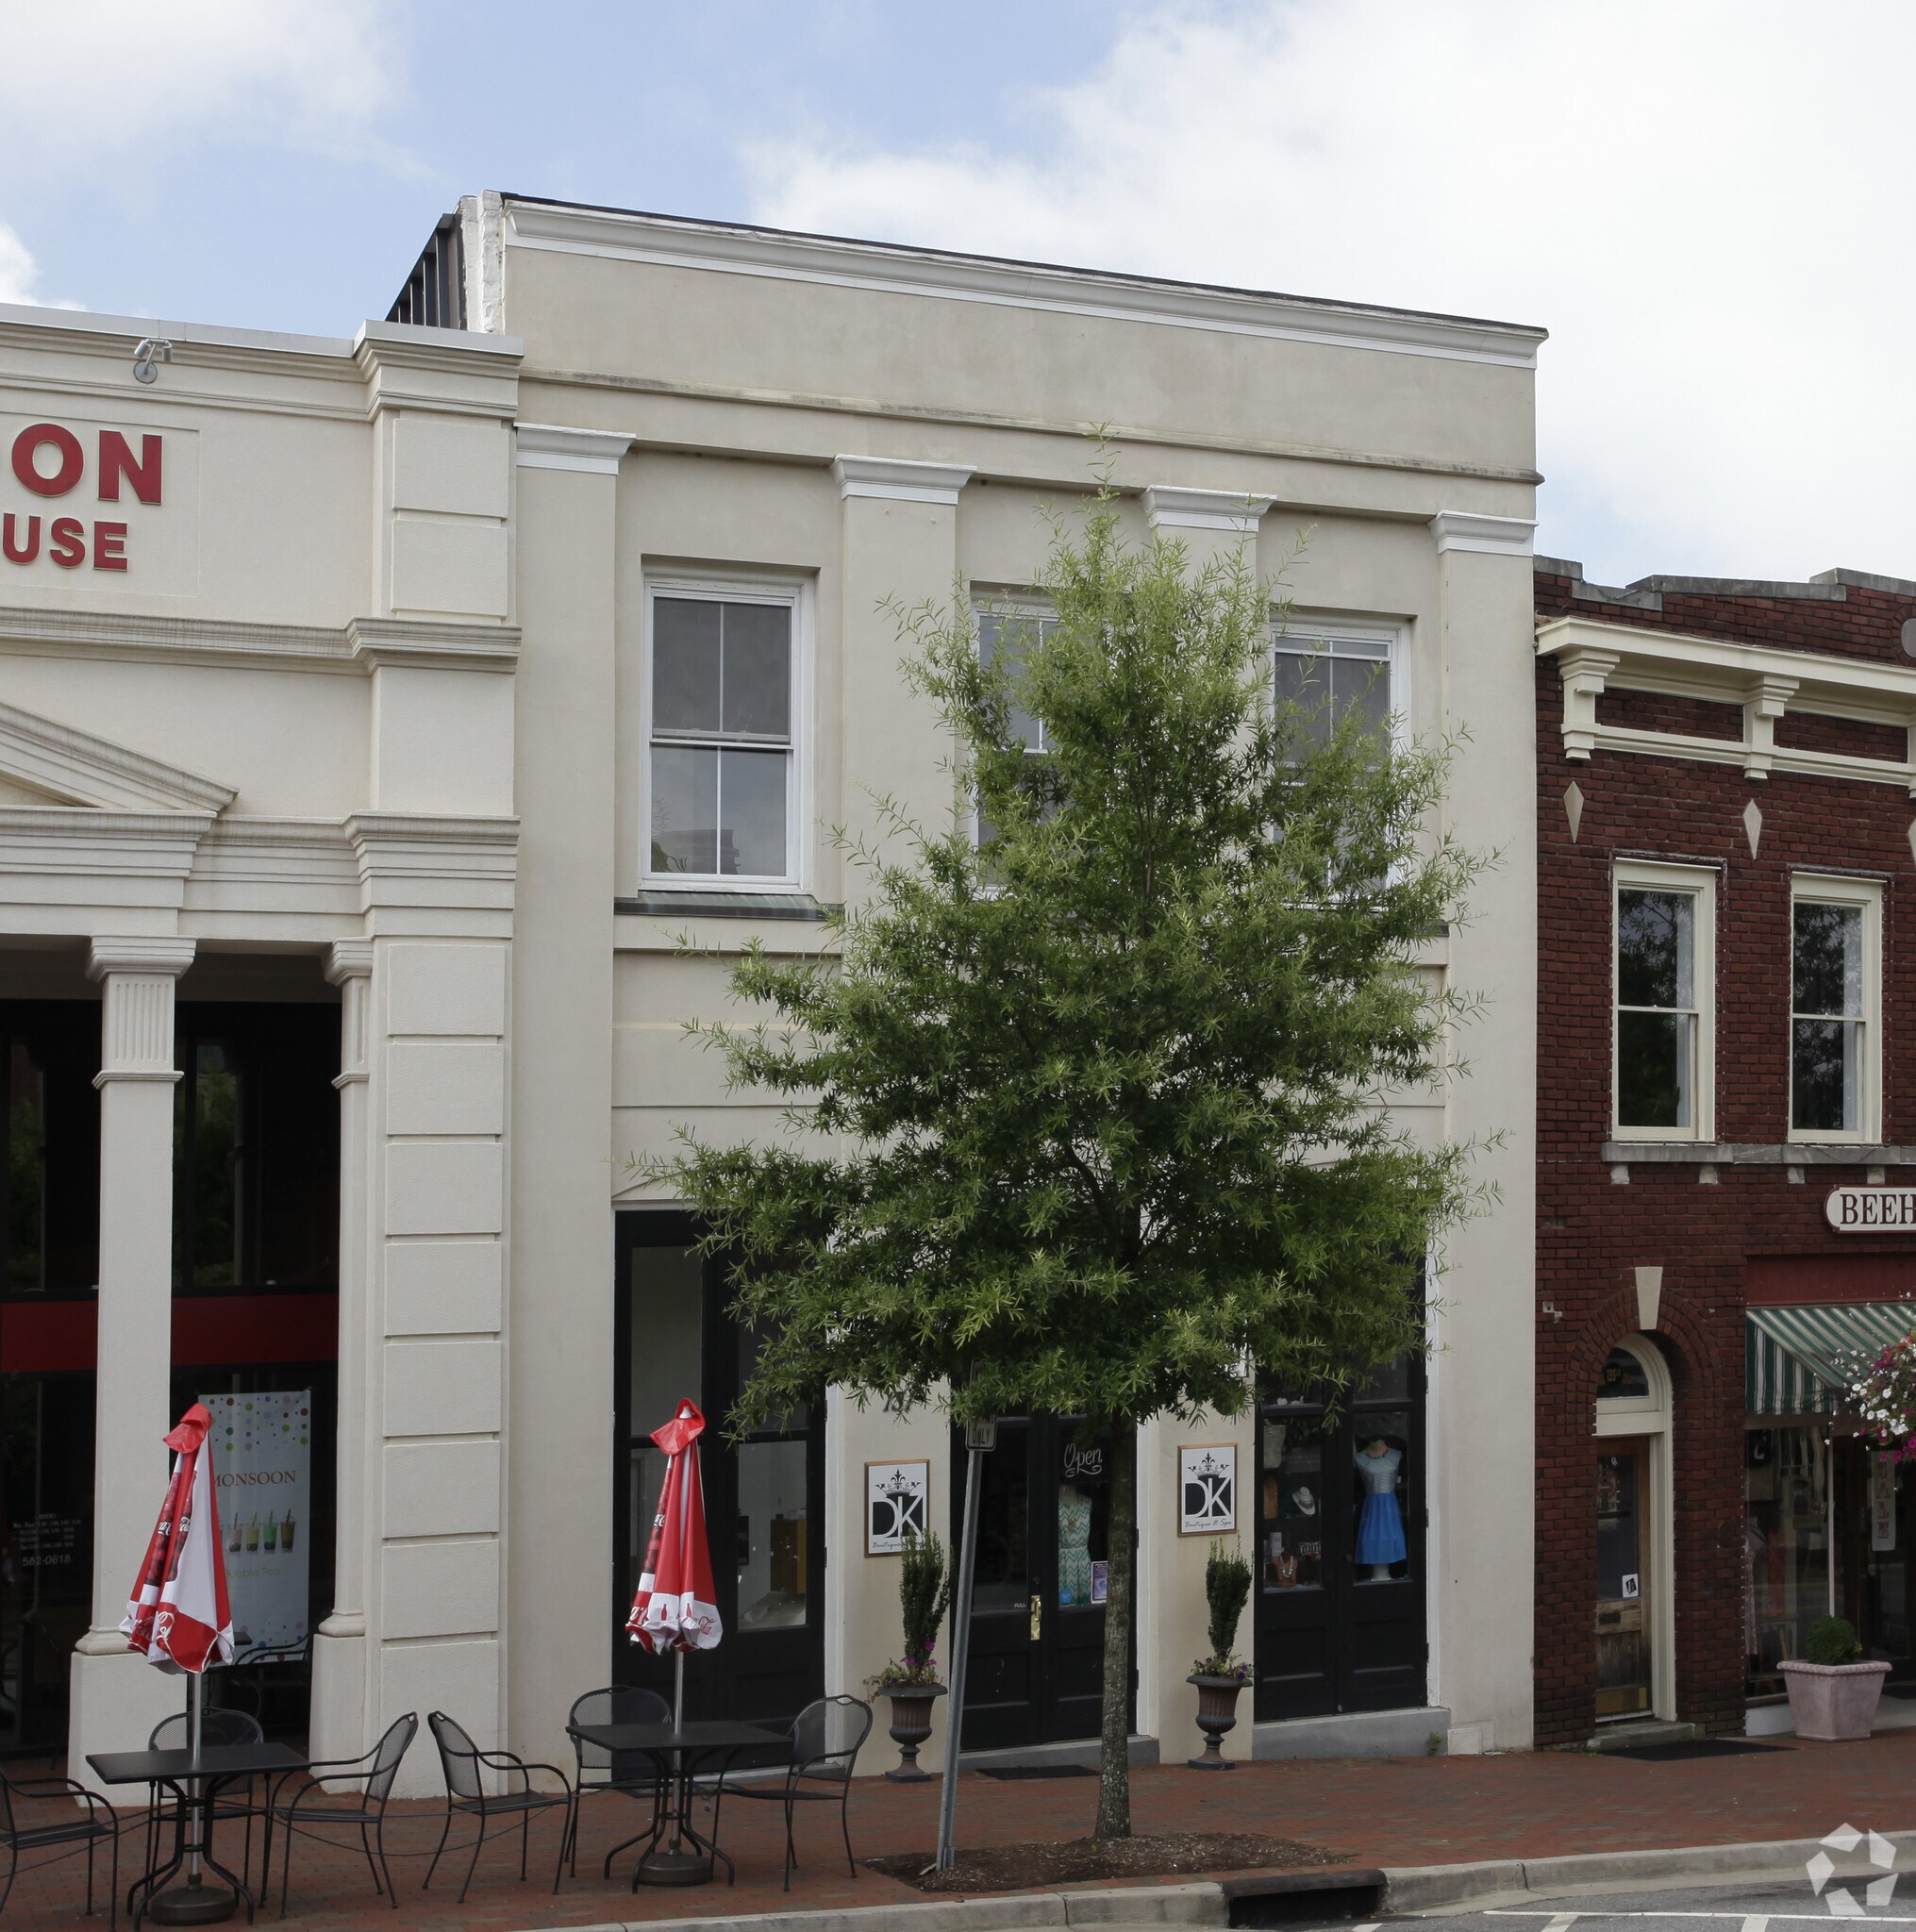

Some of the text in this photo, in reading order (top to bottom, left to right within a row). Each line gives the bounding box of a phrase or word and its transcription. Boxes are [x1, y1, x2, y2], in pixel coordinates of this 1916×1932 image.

[11, 423, 163, 506] ON
[3, 512, 128, 572] USE
[1840, 1194, 1916, 1224] BEEH
[972, 1428, 991, 1445] ONLY
[1063, 1442, 1104, 1477] Open
[870, 1494, 925, 1541] DK
[1182, 1476, 1233, 1519] DK
